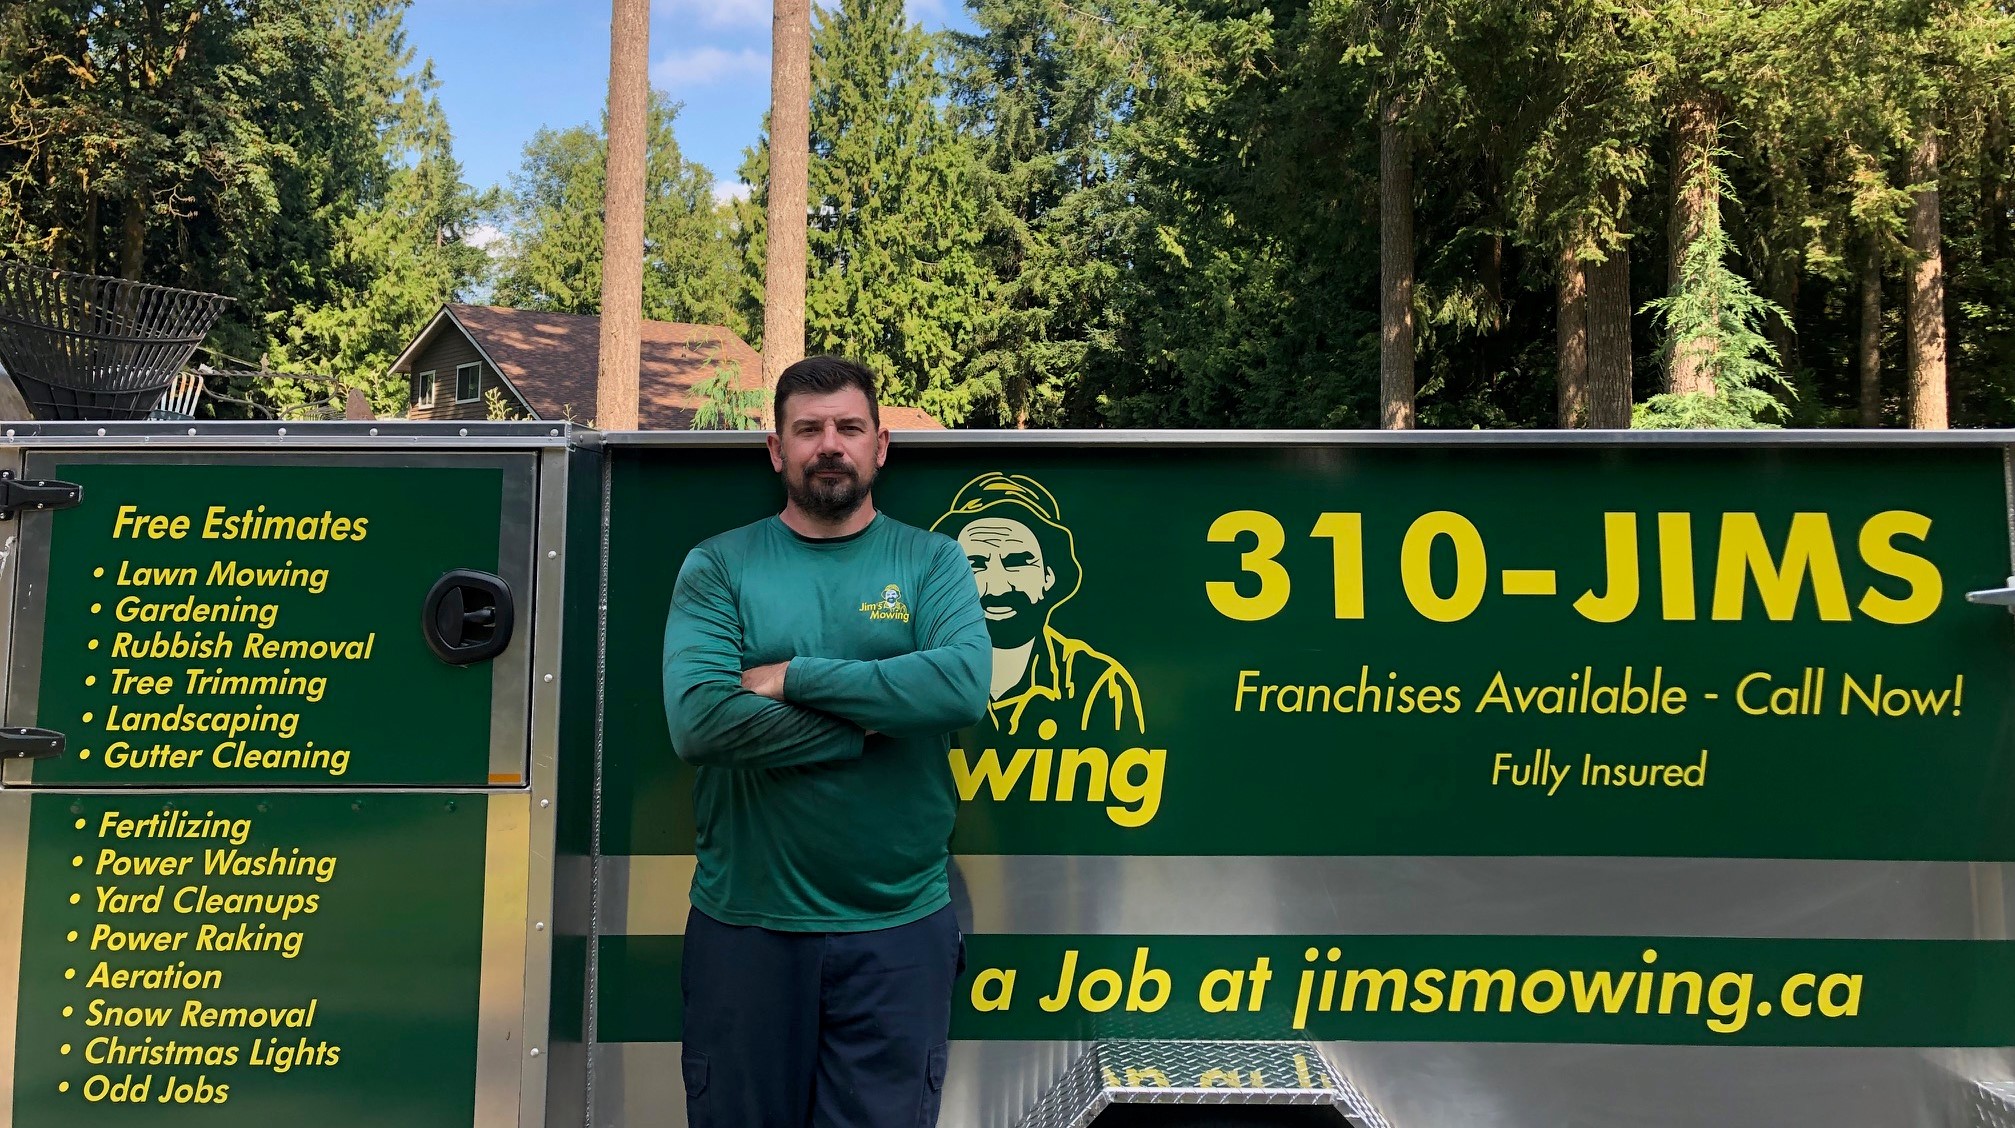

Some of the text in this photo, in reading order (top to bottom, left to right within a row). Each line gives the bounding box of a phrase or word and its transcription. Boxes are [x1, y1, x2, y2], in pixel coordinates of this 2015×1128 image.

[113, 505, 369, 542] Free Estimates
[116, 560, 329, 594] Lawn Mowing
[1205, 510, 1943, 625] 310-JIMS
[115, 595, 279, 630] Gardening
[859, 602, 883, 612] Jim's
[869, 609, 910, 623] Mowing
[111, 631, 375, 660] Rubbish Removal
[112, 668, 327, 703] Tree Trimming
[1234, 666, 1461, 713] Franchises
[1475, 666, 1687, 715] Available
[1736, 667, 1825, 716] Call
[1840, 674, 1963, 717] Now!
[105, 705, 300, 739] Landscaping
[104, 741, 350, 776] Gutter Cleaning
[948, 718, 1167, 828] wing
[1492, 749, 1708, 795] Fully Insured
[98, 811, 251, 846] Fertilizing
[95, 848, 337, 883] Power Washing
[95, 885, 319, 921] Yard Cleanups
[89, 923, 304, 959] Power Raking
[86, 961, 223, 990] Aeration
[971, 946, 1864, 1034] a Job at jimsmowing.ca
[84, 998, 318, 1028] Snow Removal
[84, 1035, 340, 1073] Christmas Lights
[83, 1073, 229, 1104] Odd Jobs
